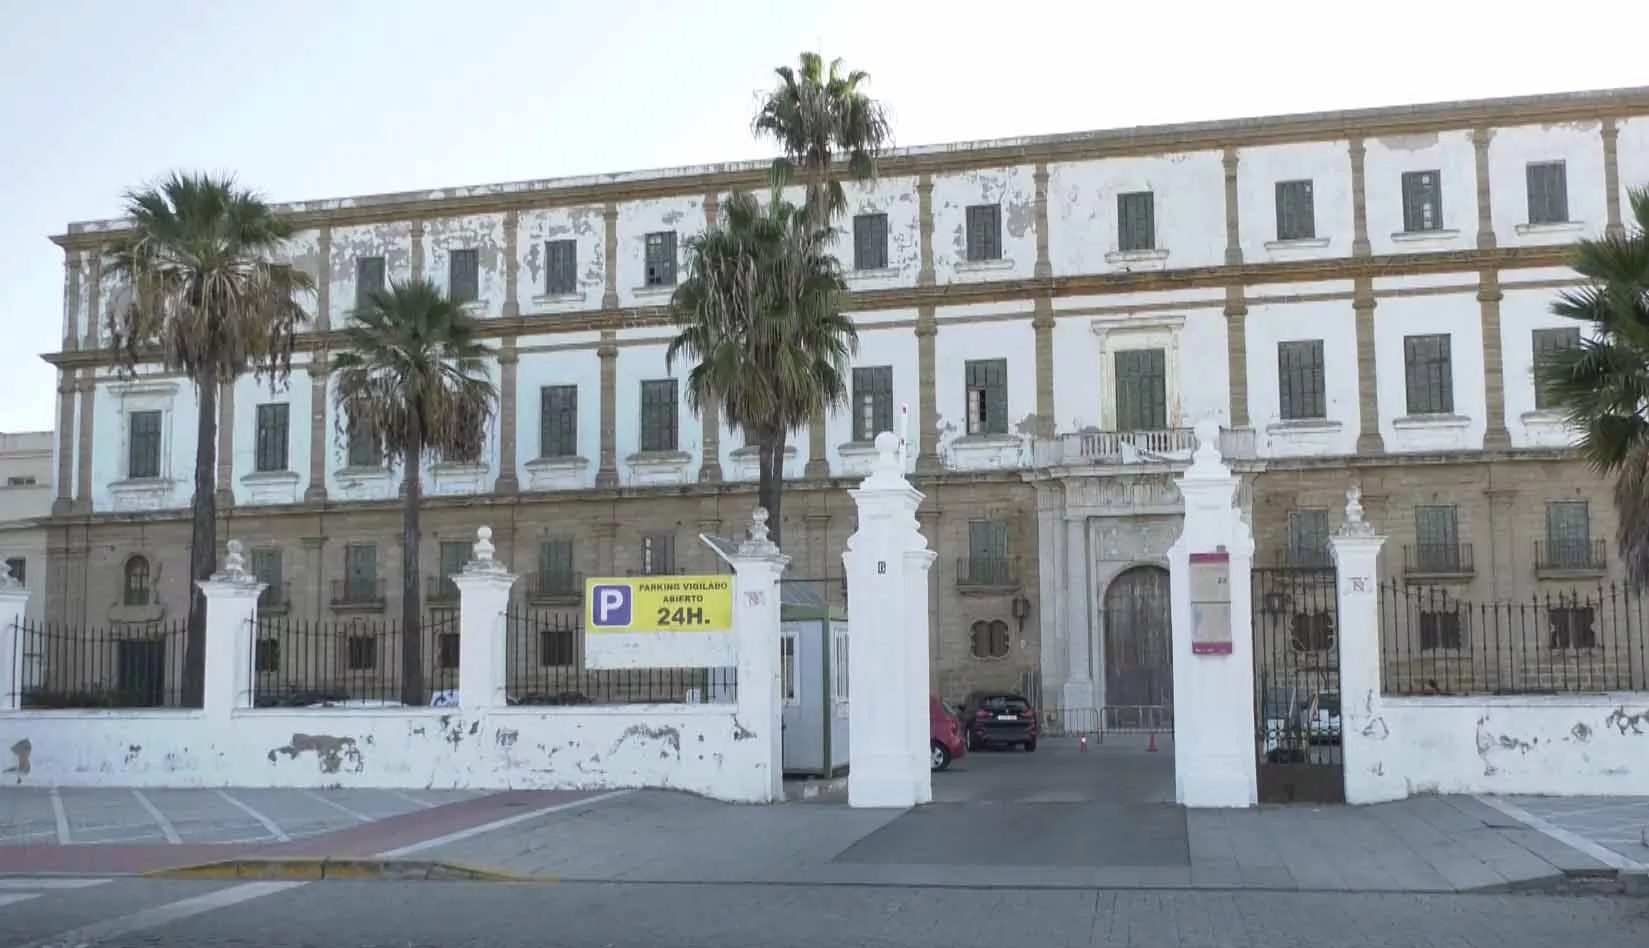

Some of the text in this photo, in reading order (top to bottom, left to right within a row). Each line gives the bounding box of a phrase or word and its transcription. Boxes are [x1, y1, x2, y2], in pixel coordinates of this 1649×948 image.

[639, 582, 728, 592] PARKING VIGILADO
[600, 588, 624, 622] P
[663, 594, 704, 603] ABIERTO
[657, 606, 711, 626] 24H.
